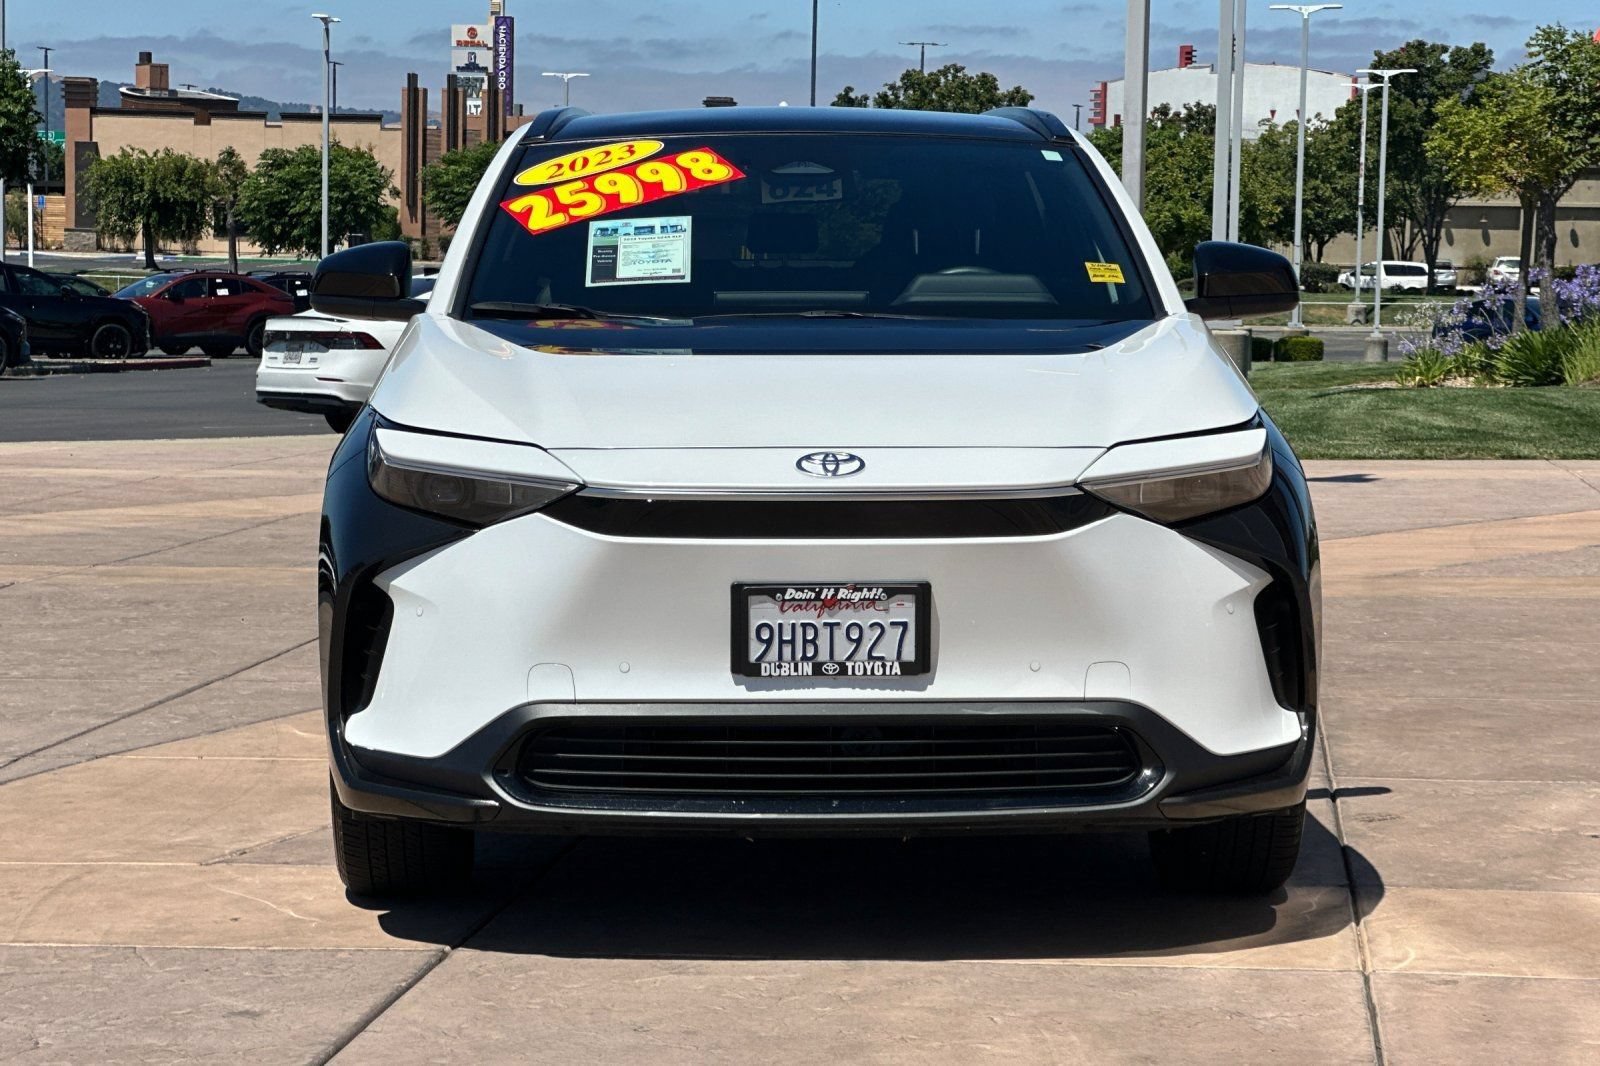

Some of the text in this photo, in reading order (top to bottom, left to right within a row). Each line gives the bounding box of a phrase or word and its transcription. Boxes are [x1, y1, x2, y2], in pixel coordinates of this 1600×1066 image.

[546, 144, 637, 181] 2023
[508, 150, 734, 231] 25998
[784, 588, 883, 602] Doin' It Right!
[754, 621, 909, 662] 9HBT927
[761, 662, 901, 676] DUBLIN TOYOTA
